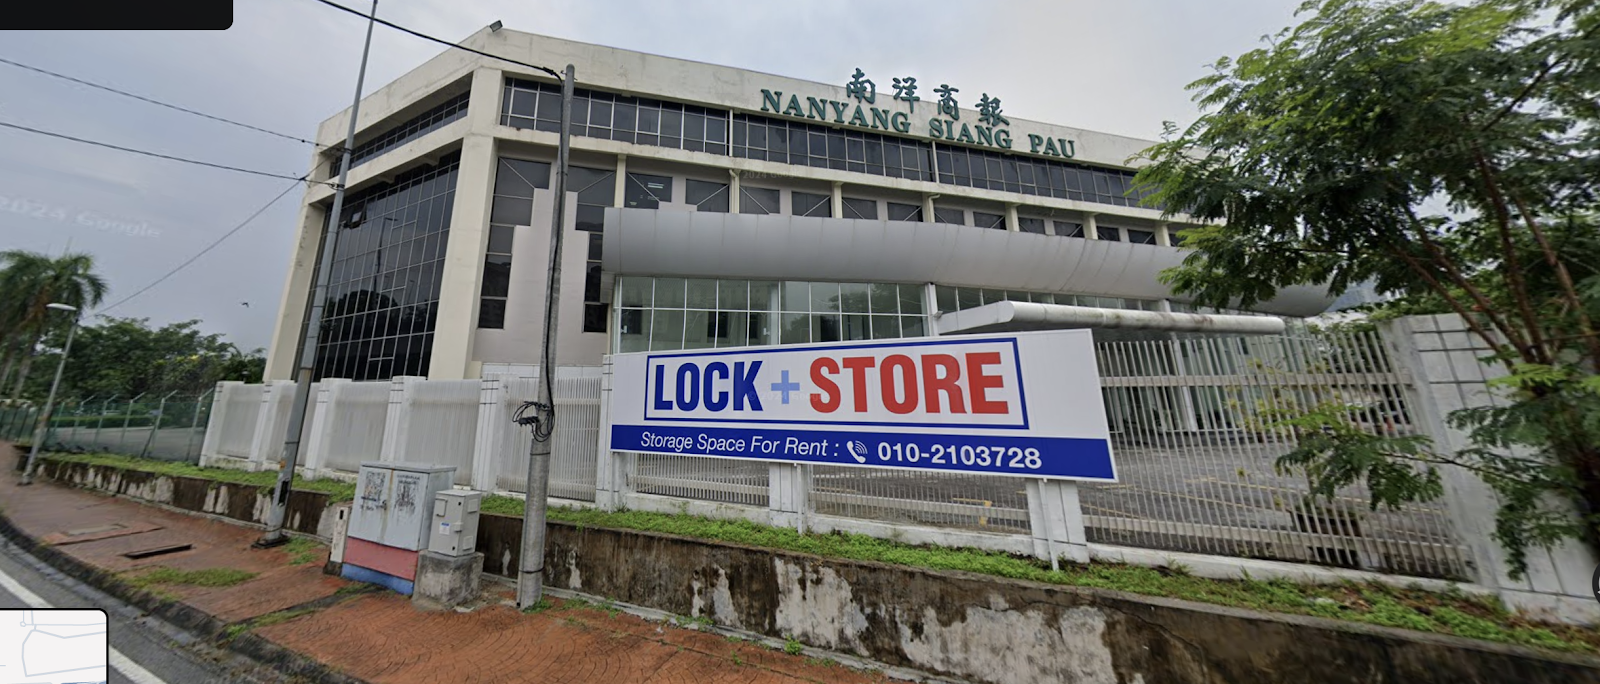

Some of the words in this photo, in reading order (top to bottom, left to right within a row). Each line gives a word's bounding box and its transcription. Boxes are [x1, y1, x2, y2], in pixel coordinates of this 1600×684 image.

[761, 89, 911, 133] NANYANG
[929, 116, 1013, 149] SIANG
[1028, 133, 1076, 158] PAU
[846, 67, 1010, 127] 南洋商報
[654, 361, 763, 412] LOCK
[810, 352, 1008, 414] STORE
[640, 431, 693, 453] Storage
[697, 434, 746, 454] Space
[750, 437, 781, 453] For
[784, 437, 829, 456] Rent
[877, 442, 1042, 469] 010-2103728
